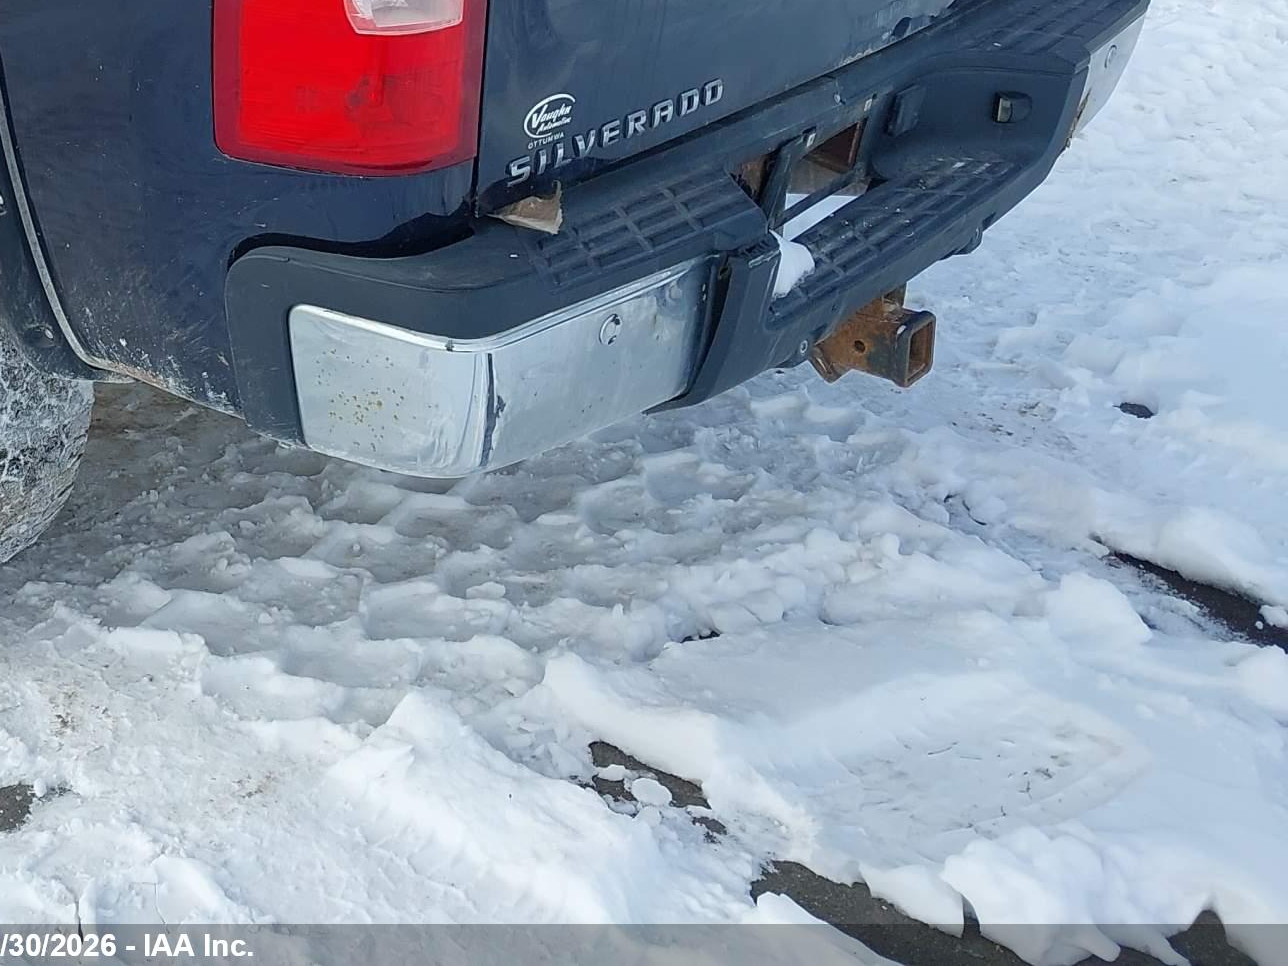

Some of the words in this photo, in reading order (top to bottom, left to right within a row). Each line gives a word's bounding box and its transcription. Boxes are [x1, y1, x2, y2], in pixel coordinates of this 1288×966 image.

[531, 103, 572, 128] Vaughn
[507, 78, 724, 188] SILVERADO
[528, 131, 565, 150] OTTUMWA
